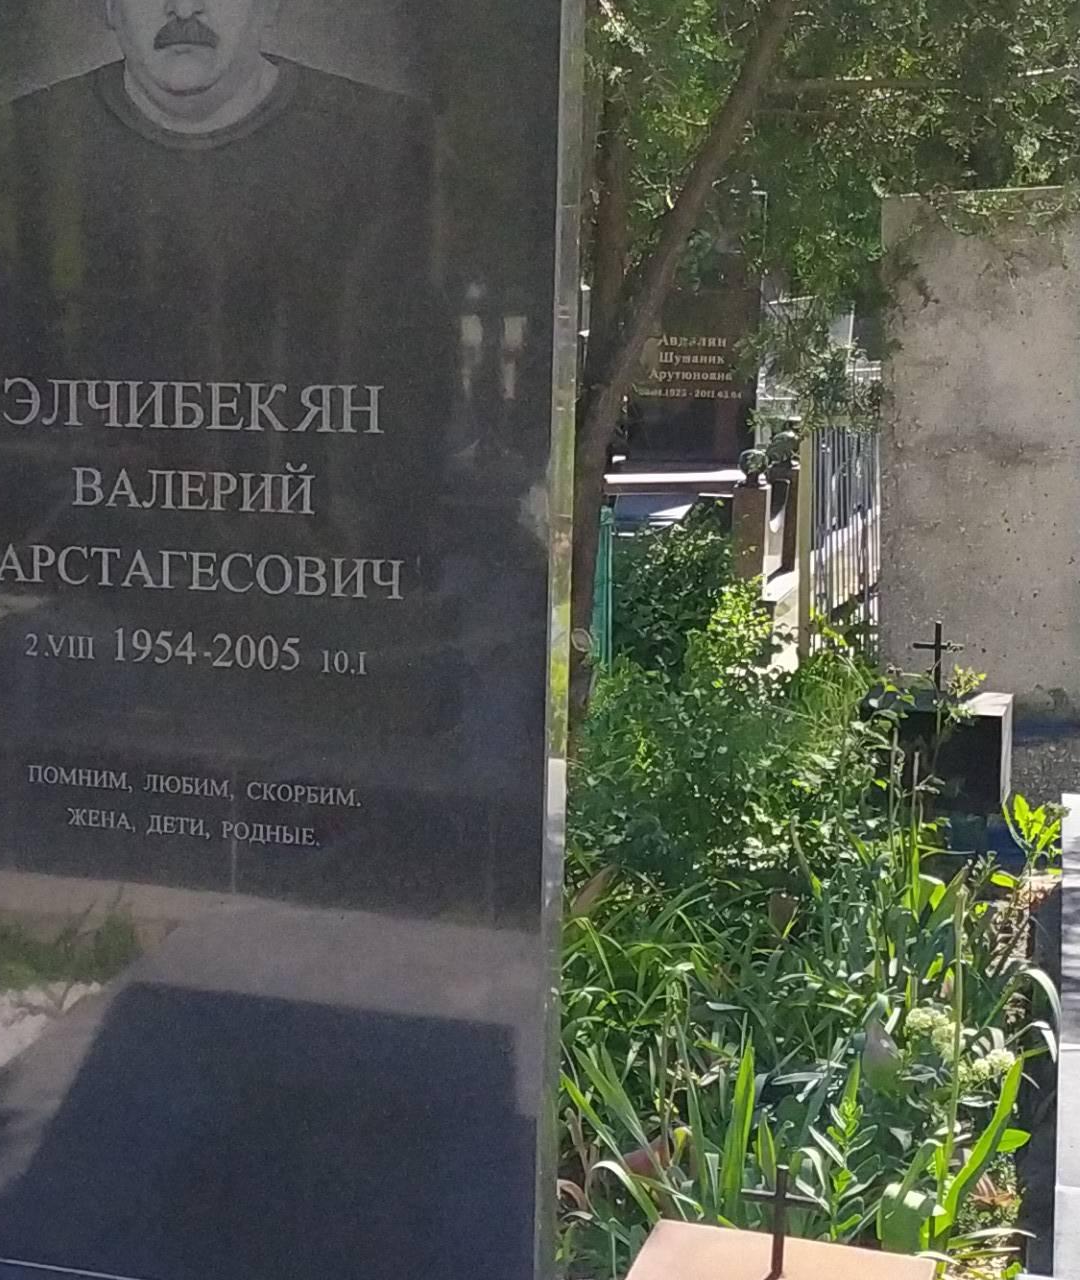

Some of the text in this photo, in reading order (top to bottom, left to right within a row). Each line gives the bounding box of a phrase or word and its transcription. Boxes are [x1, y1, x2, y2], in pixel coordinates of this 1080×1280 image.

[2, 377, 385, 434] ЭЛЧИБЕКЯН
[71, 463, 316, 515] ВАЛЕРИЙ
[114, 628, 302, 670] 1954-2005
[320, 649, 368, 675] 10.I
[28, 765, 362, 808] ПОМНИМ, ЛЮБИМ, СКОРБИМ.
[68, 808, 320, 847] ЖЕНА, ДЕТИ, РОДНЫЕ.
